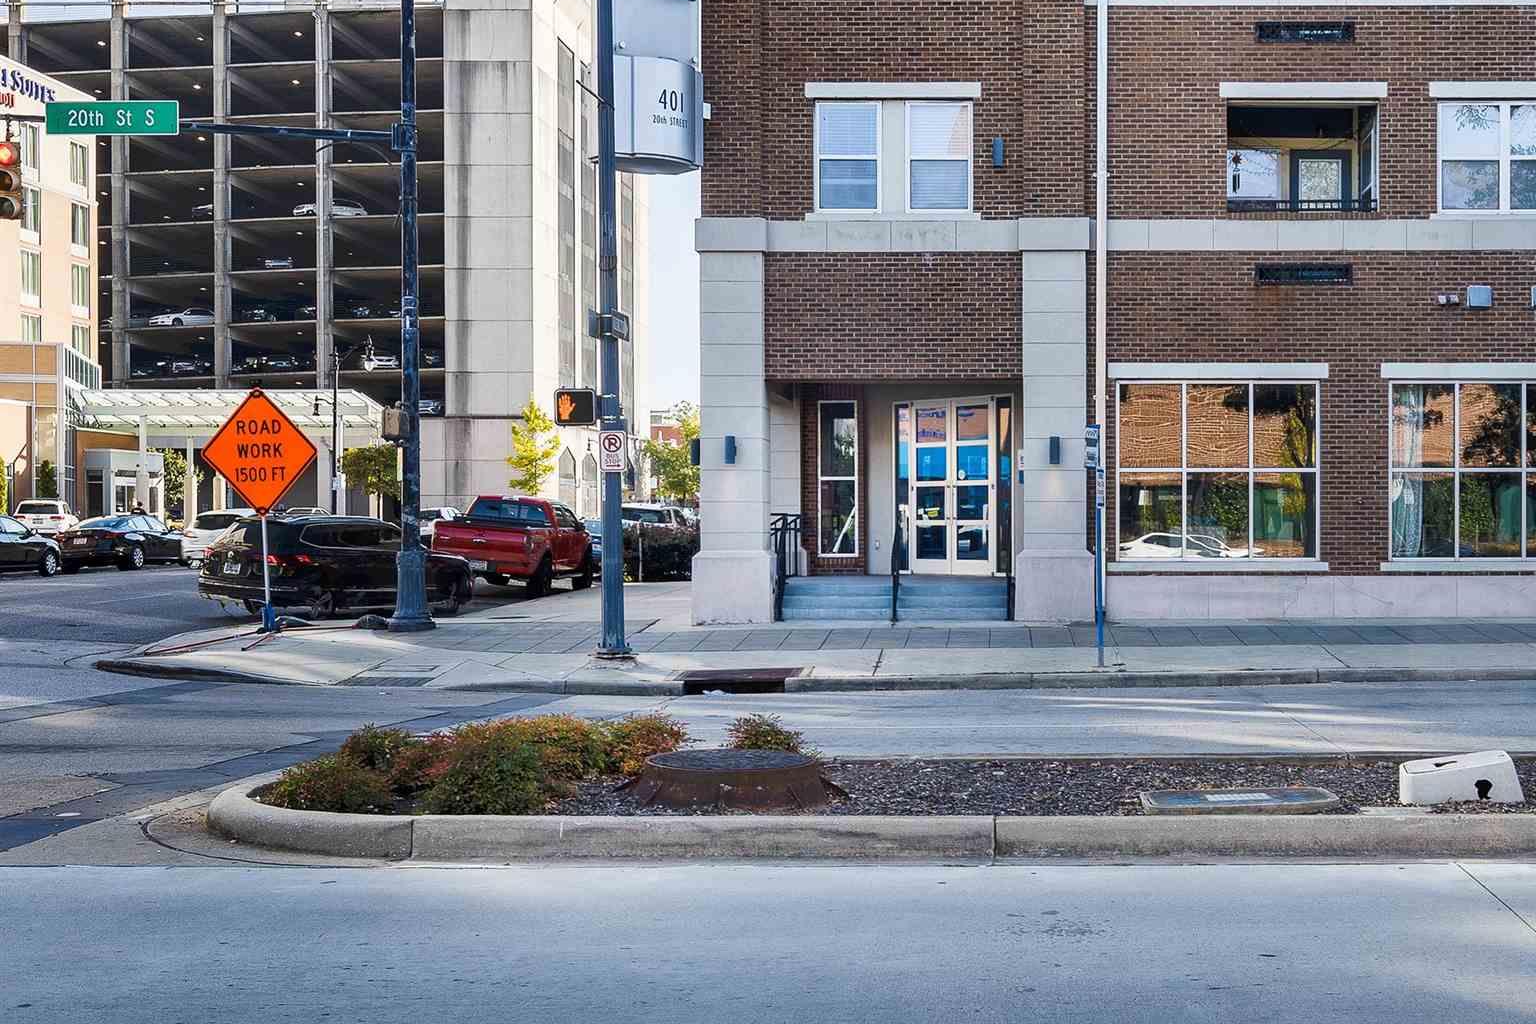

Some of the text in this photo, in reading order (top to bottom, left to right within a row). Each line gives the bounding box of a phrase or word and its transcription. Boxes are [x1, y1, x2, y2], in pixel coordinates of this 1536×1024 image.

[659, 89, 684, 113] 401
[68, 109, 155, 127] 20th St S
[236, 419, 281, 435] ROAD
[237, 443, 283, 458] WORK
[235, 466, 286, 482] 1500 FT
